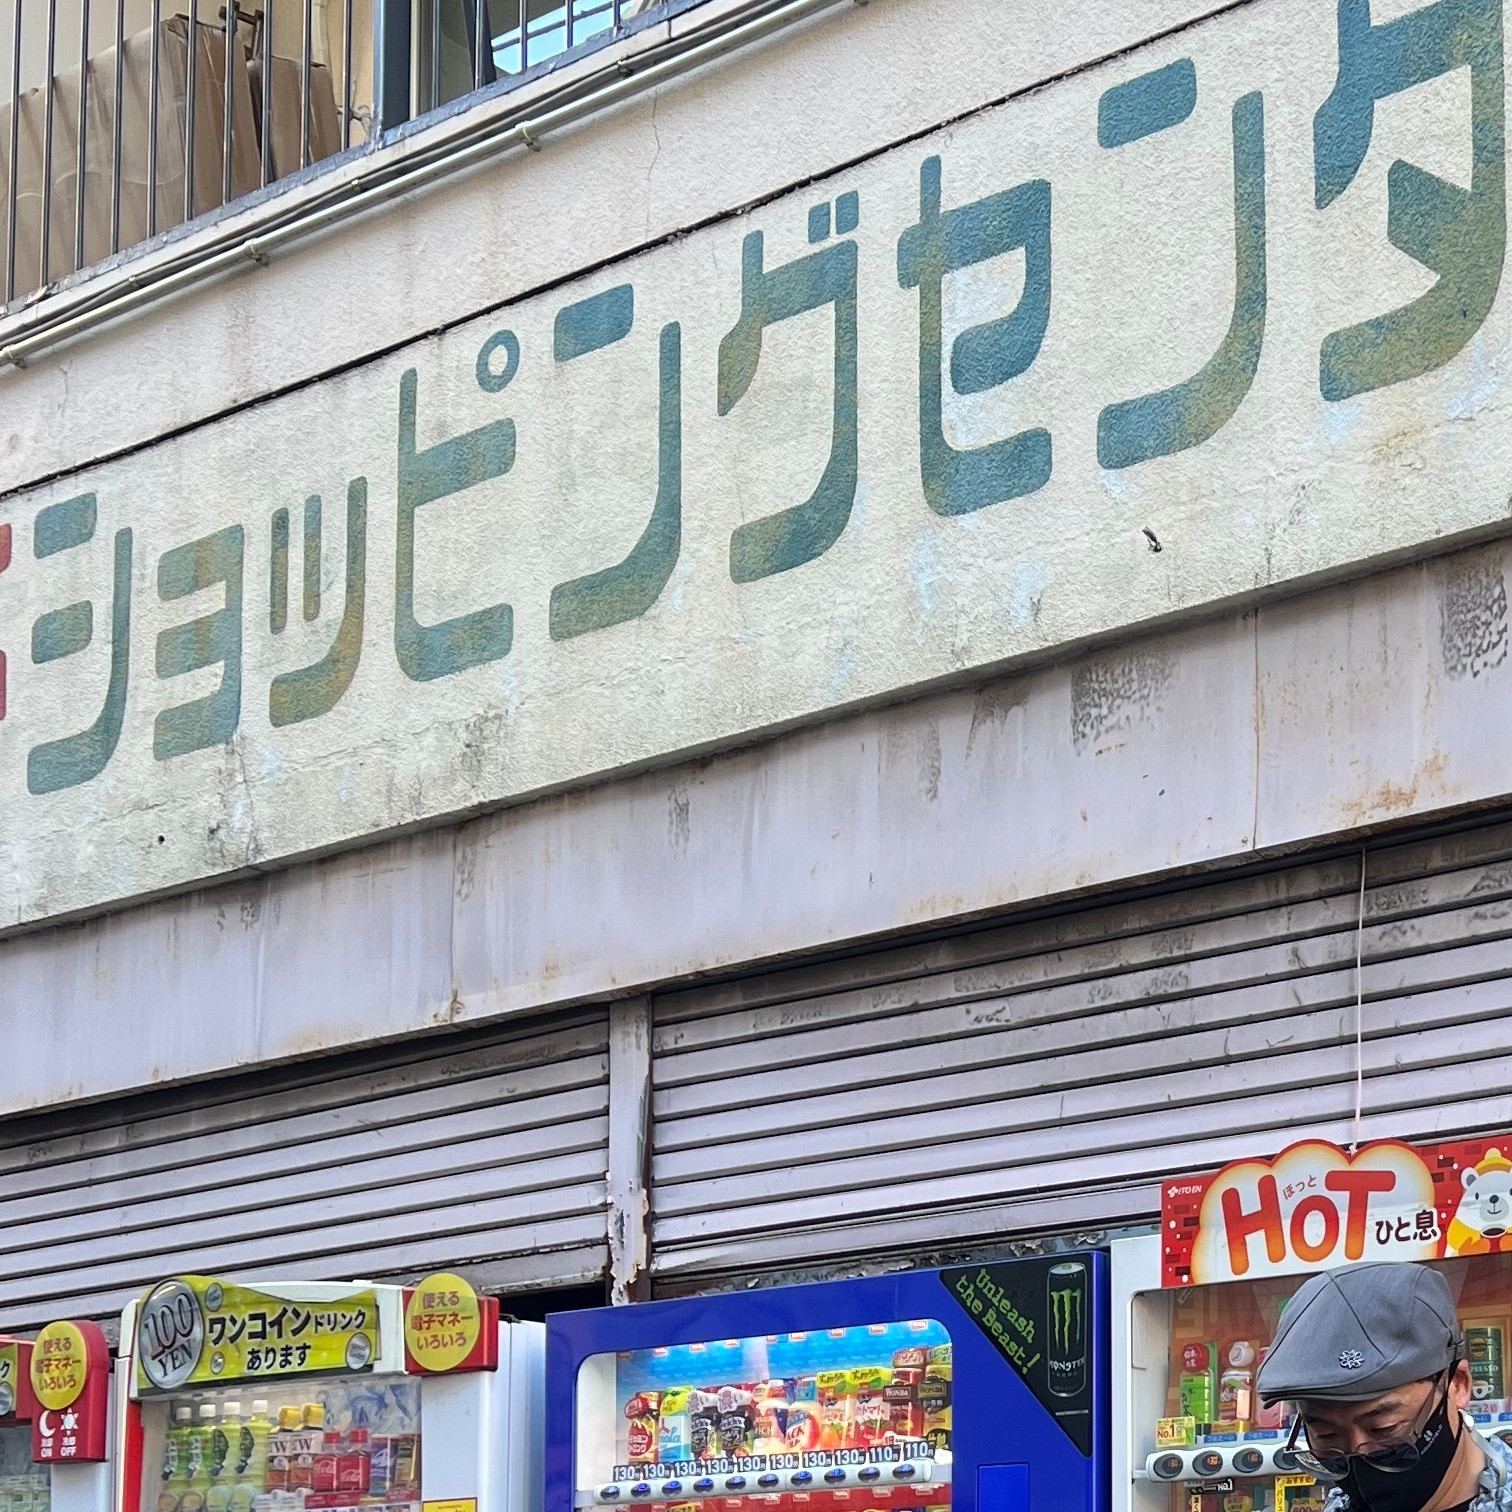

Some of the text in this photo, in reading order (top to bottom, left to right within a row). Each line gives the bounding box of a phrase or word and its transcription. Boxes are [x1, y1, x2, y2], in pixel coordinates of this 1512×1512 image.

[1283, 1174, 1318, 1201] ほっと
[1375, 1210, 1438, 1246] ひと息
[422, 1290, 460, 1310] 使える
[975, 1267, 1035, 1344] Unleash
[144, 1293, 195, 1351] 100
[208, 1305, 367, 1347] ワンコインドリンク
[410, 1312, 474, 1330] 電子マネー
[956, 1274, 1041, 1375] the Beast!
[416, 1331, 468, 1350] いろいろ
[155, 1339, 194, 1378] YEN
[246, 1342, 312, 1371] あります
[38, 1374, 76, 1391] いろいろ
[1157, 1424, 1175, 1439] No.1
[60, 1446, 77, 1457] OFF
